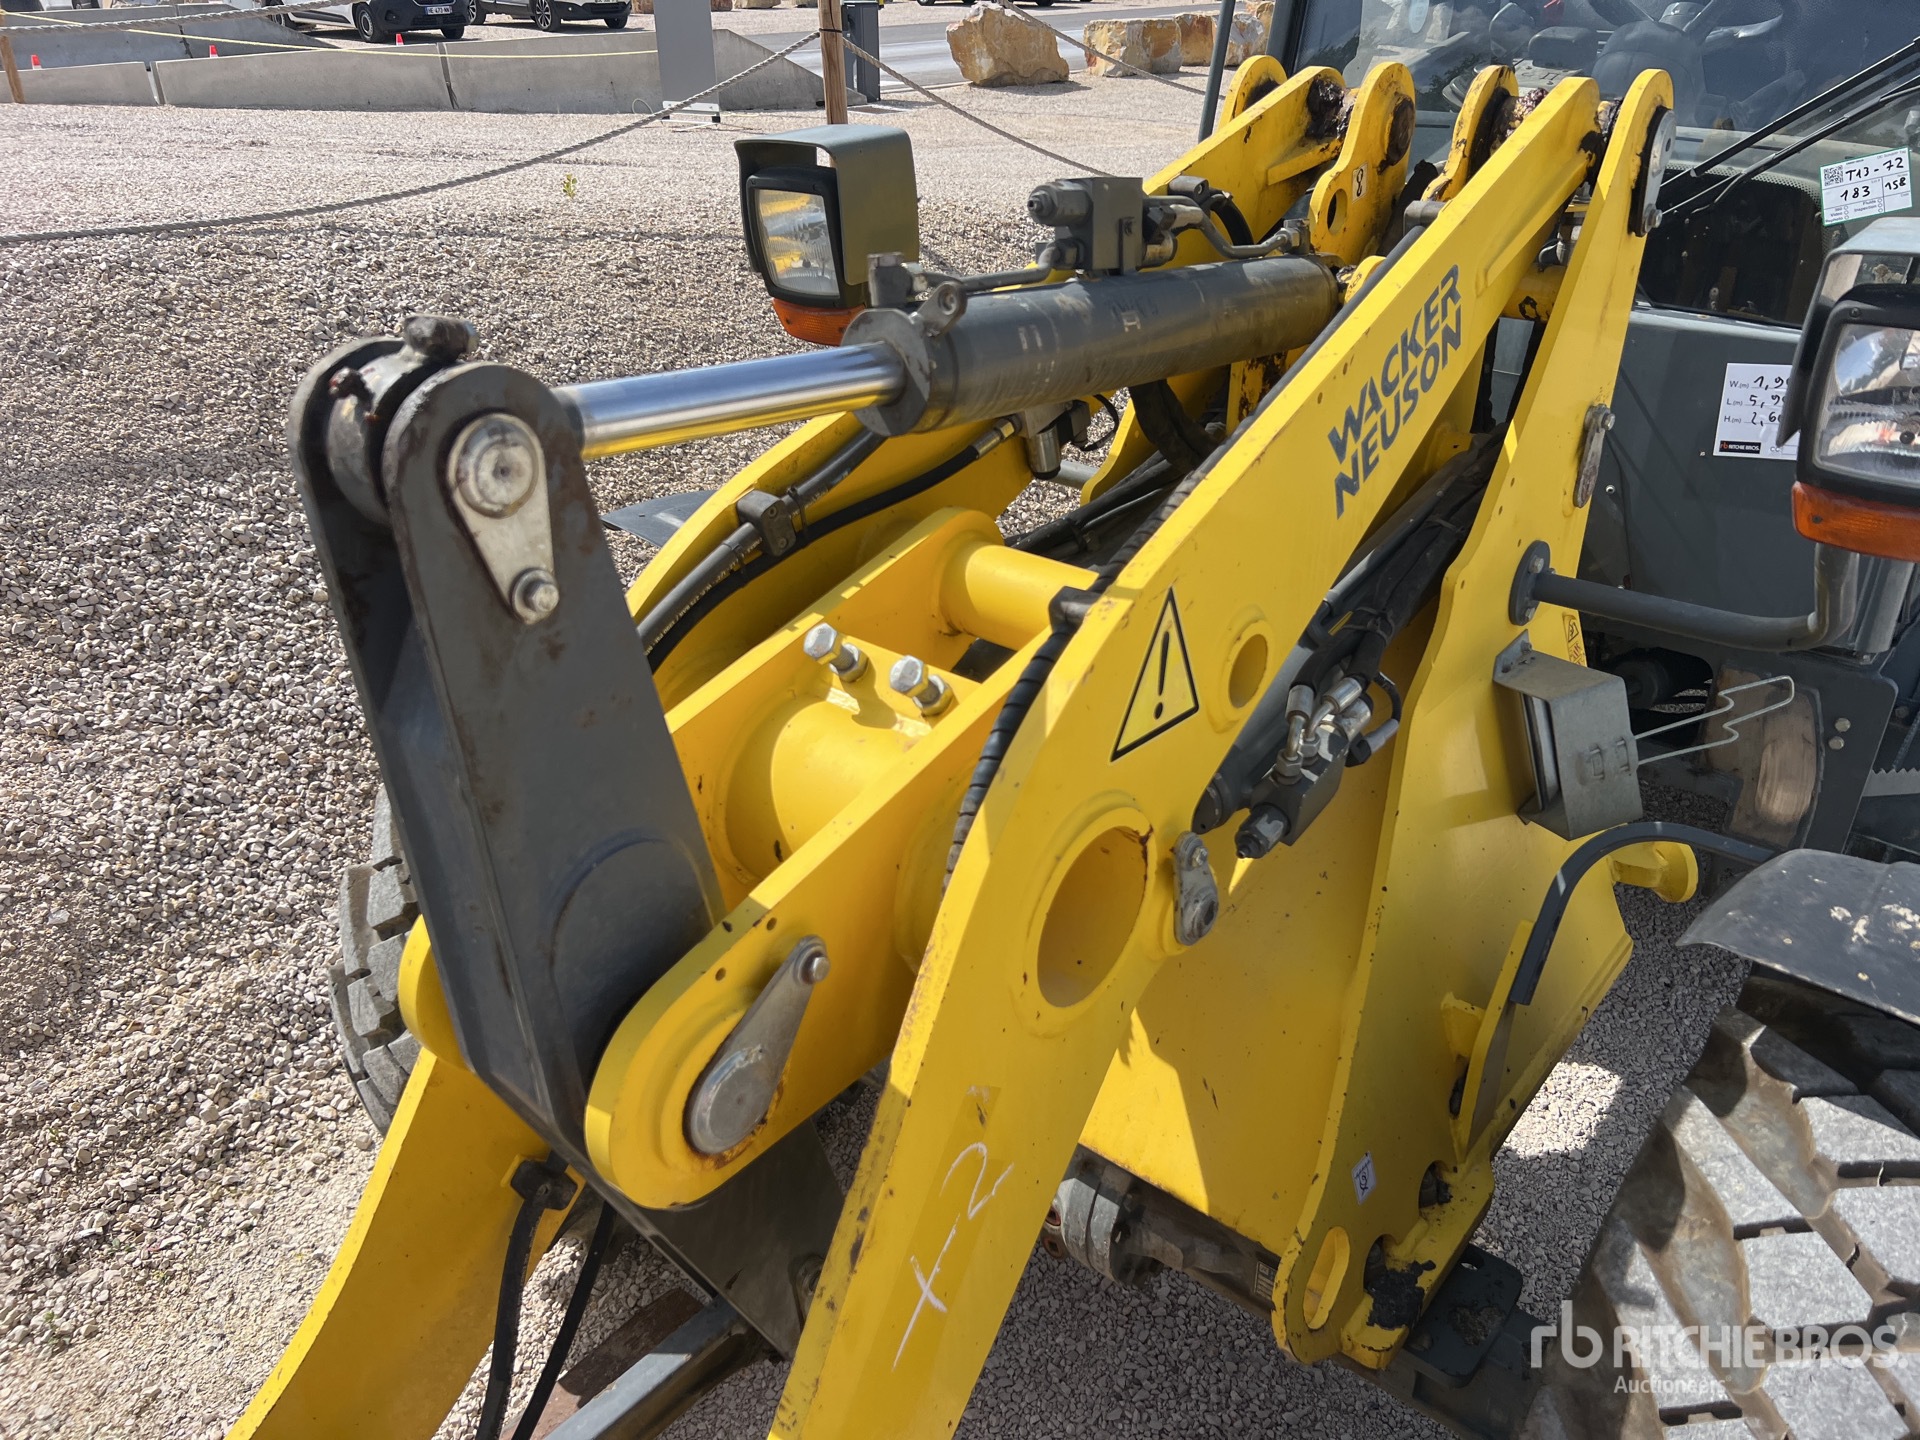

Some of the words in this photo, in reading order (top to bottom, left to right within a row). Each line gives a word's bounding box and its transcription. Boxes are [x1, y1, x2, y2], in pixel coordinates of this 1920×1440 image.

[1845, 166, 1869, 181] T13
[1882, 157, 1904, 171] 72
[1840, 185, 1871, 201] 183
[1884, 177, 1906, 191] 158
[1328, 264, 1462, 464] WACKER
[1750, 395, 1786, 408] 5,9
[1334, 304, 1461, 520] NEUSON
